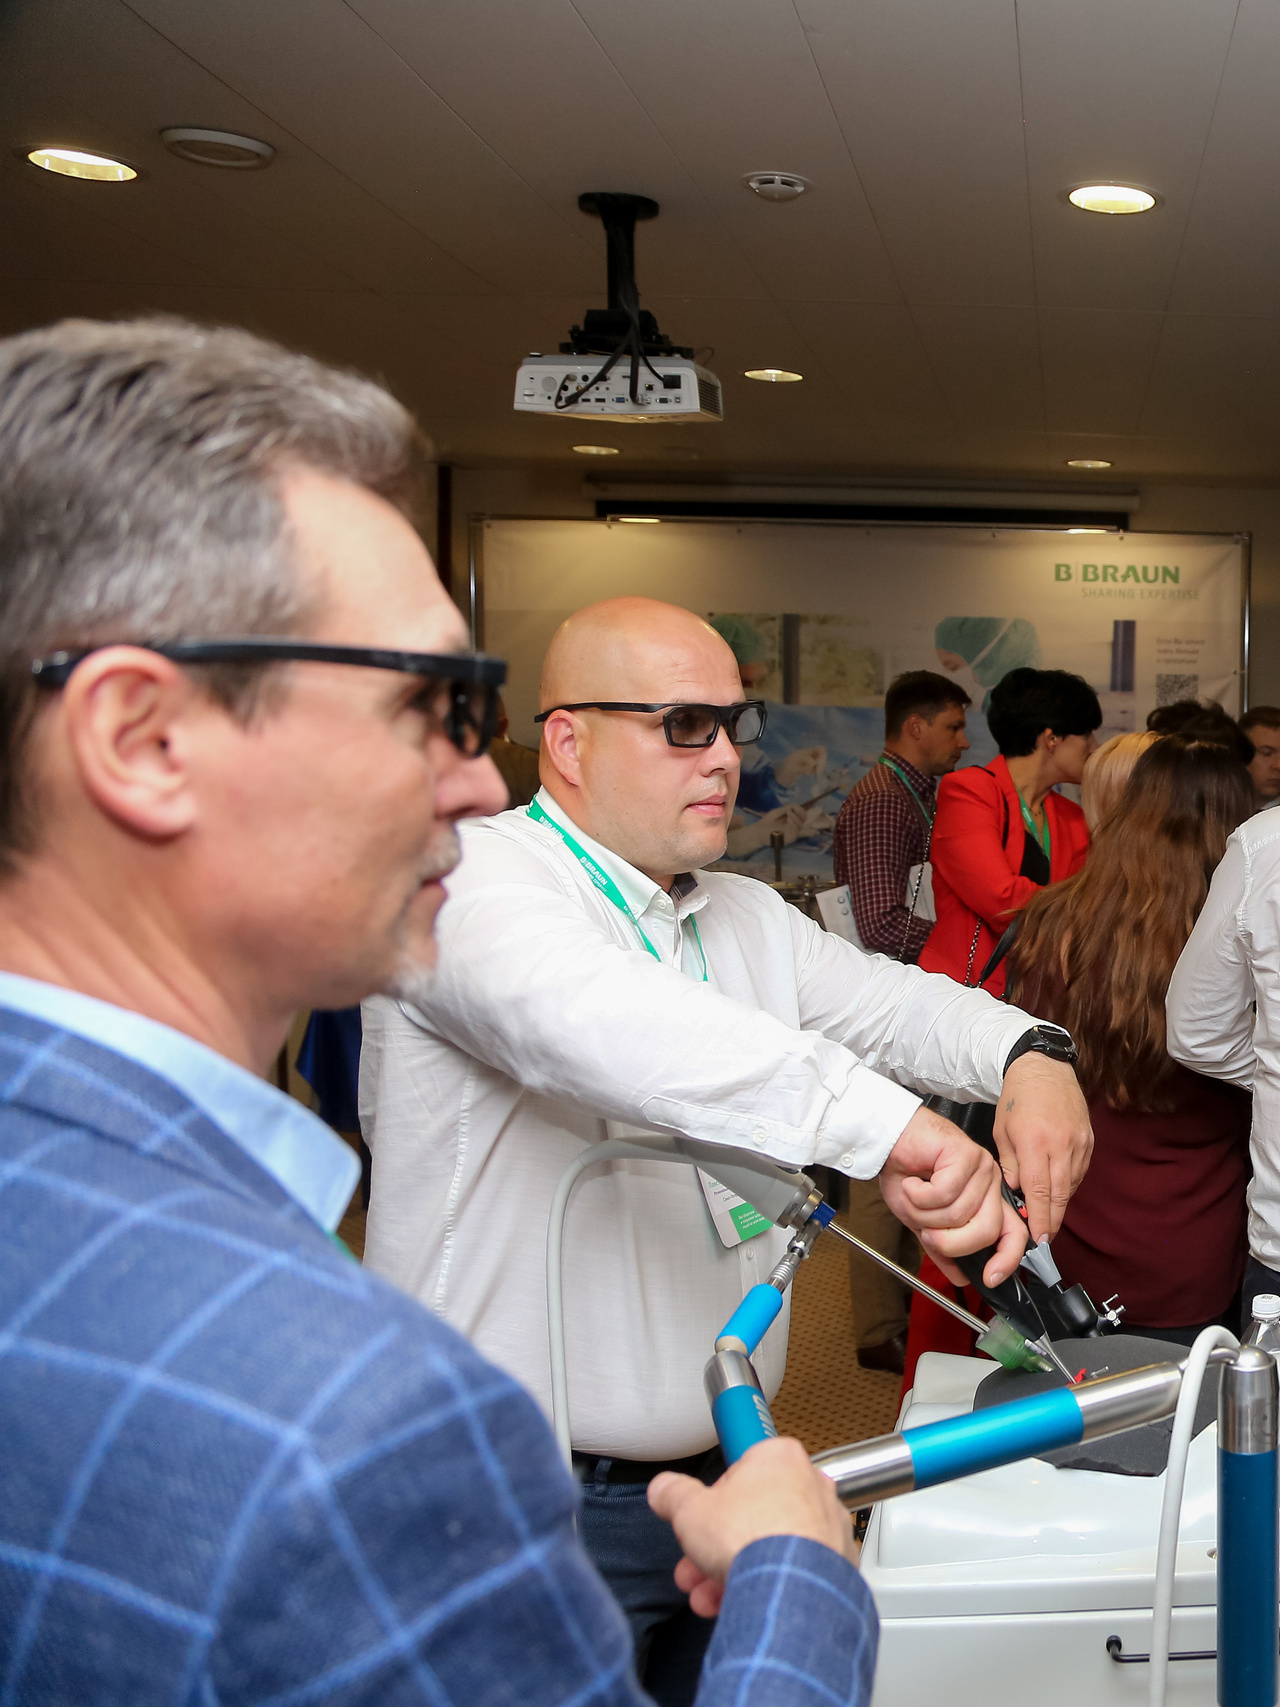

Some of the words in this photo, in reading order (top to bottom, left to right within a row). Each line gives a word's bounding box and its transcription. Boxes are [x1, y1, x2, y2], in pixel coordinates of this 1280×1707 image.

[1054, 563, 1072, 582] B
[1082, 563, 1180, 584] BRAUN
[1081, 587, 1135, 599] SHARING
[1139, 588, 1200, 600] EXPERTISE
[543, 818, 565, 840] BRAUN
[584, 860, 608, 886] BRAUN
